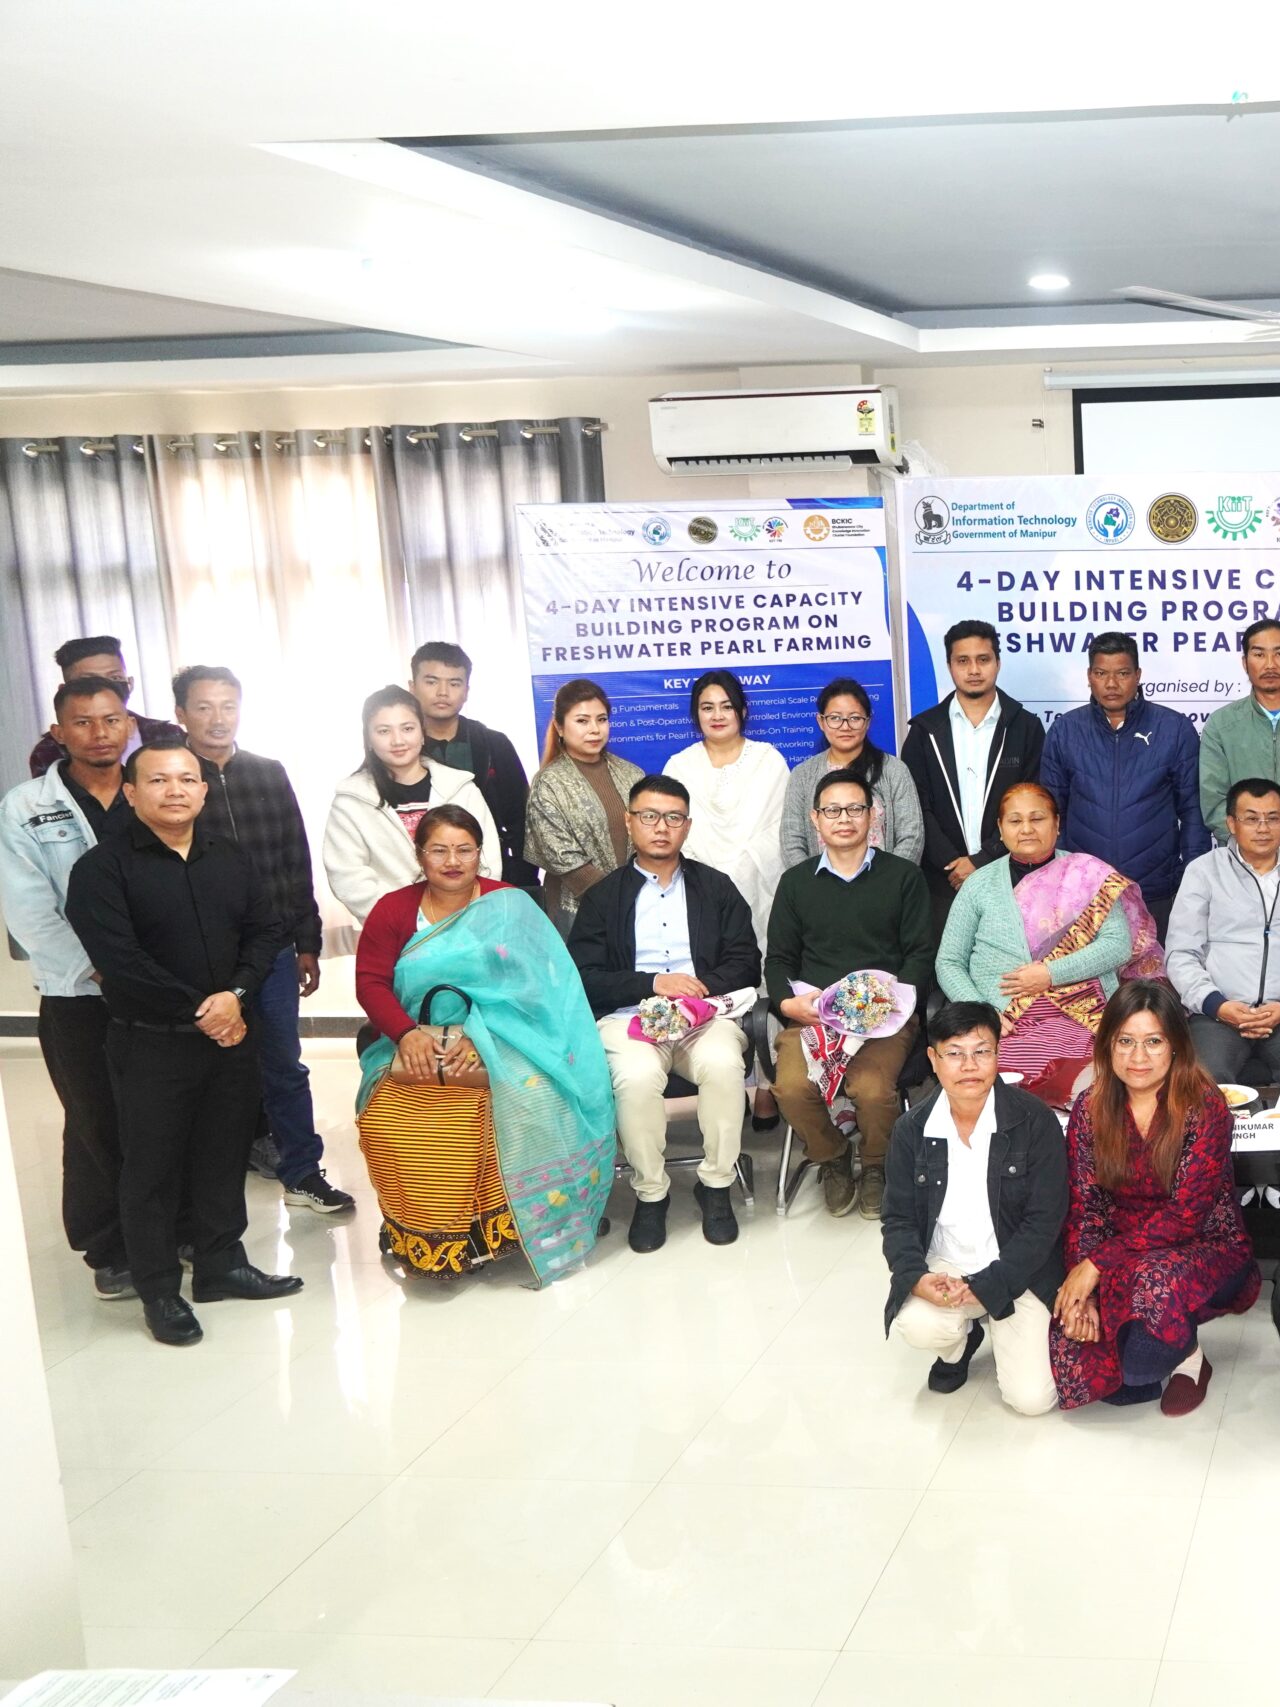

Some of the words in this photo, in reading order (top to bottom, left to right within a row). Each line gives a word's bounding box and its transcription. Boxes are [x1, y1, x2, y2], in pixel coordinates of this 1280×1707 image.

[951, 502, 1004, 512] Department
[1005, 501, 1016, 510] of
[951, 516, 1014, 526] Information
[1017, 514, 1077, 528] Technology
[952, 530, 1007, 539] Government
[1008, 529, 1018, 538] of
[1019, 529, 1057, 540] Manipur
[630, 558, 755, 584] Welcome
[766, 560, 792, 580] to
[956, 570, 1060, 592] 4-DAY
[1074, 568, 1241, 591] INTENSIVE
[546, 598, 621, 615] 4-DAY
[630, 595, 745, 613] INTENSIVE
[753, 591, 863, 608] CAPACITY
[997, 600, 1148, 622] BUILDING
[576, 621, 683, 638] BUILDING
[691, 615, 800, 634] PROGRAM
[808, 614, 838, 629] ON
[541, 642, 692, 662] FRESHWATER
[701, 639, 767, 656] PEARL
[774, 635, 872, 652] FARMING
[663, 678, 690, 689] KEY
[1138, 679, 1210, 697] rganised
[1213, 679, 1234, 697] by
[787, 696, 808, 705] Scale
[619, 703, 680, 713] Fundamentals
[637, 717, 695, 727] Post-Operativ
[655, 733, 666, 741] for
[668, 732, 689, 740] Pearl
[782, 726, 814, 735] Training
